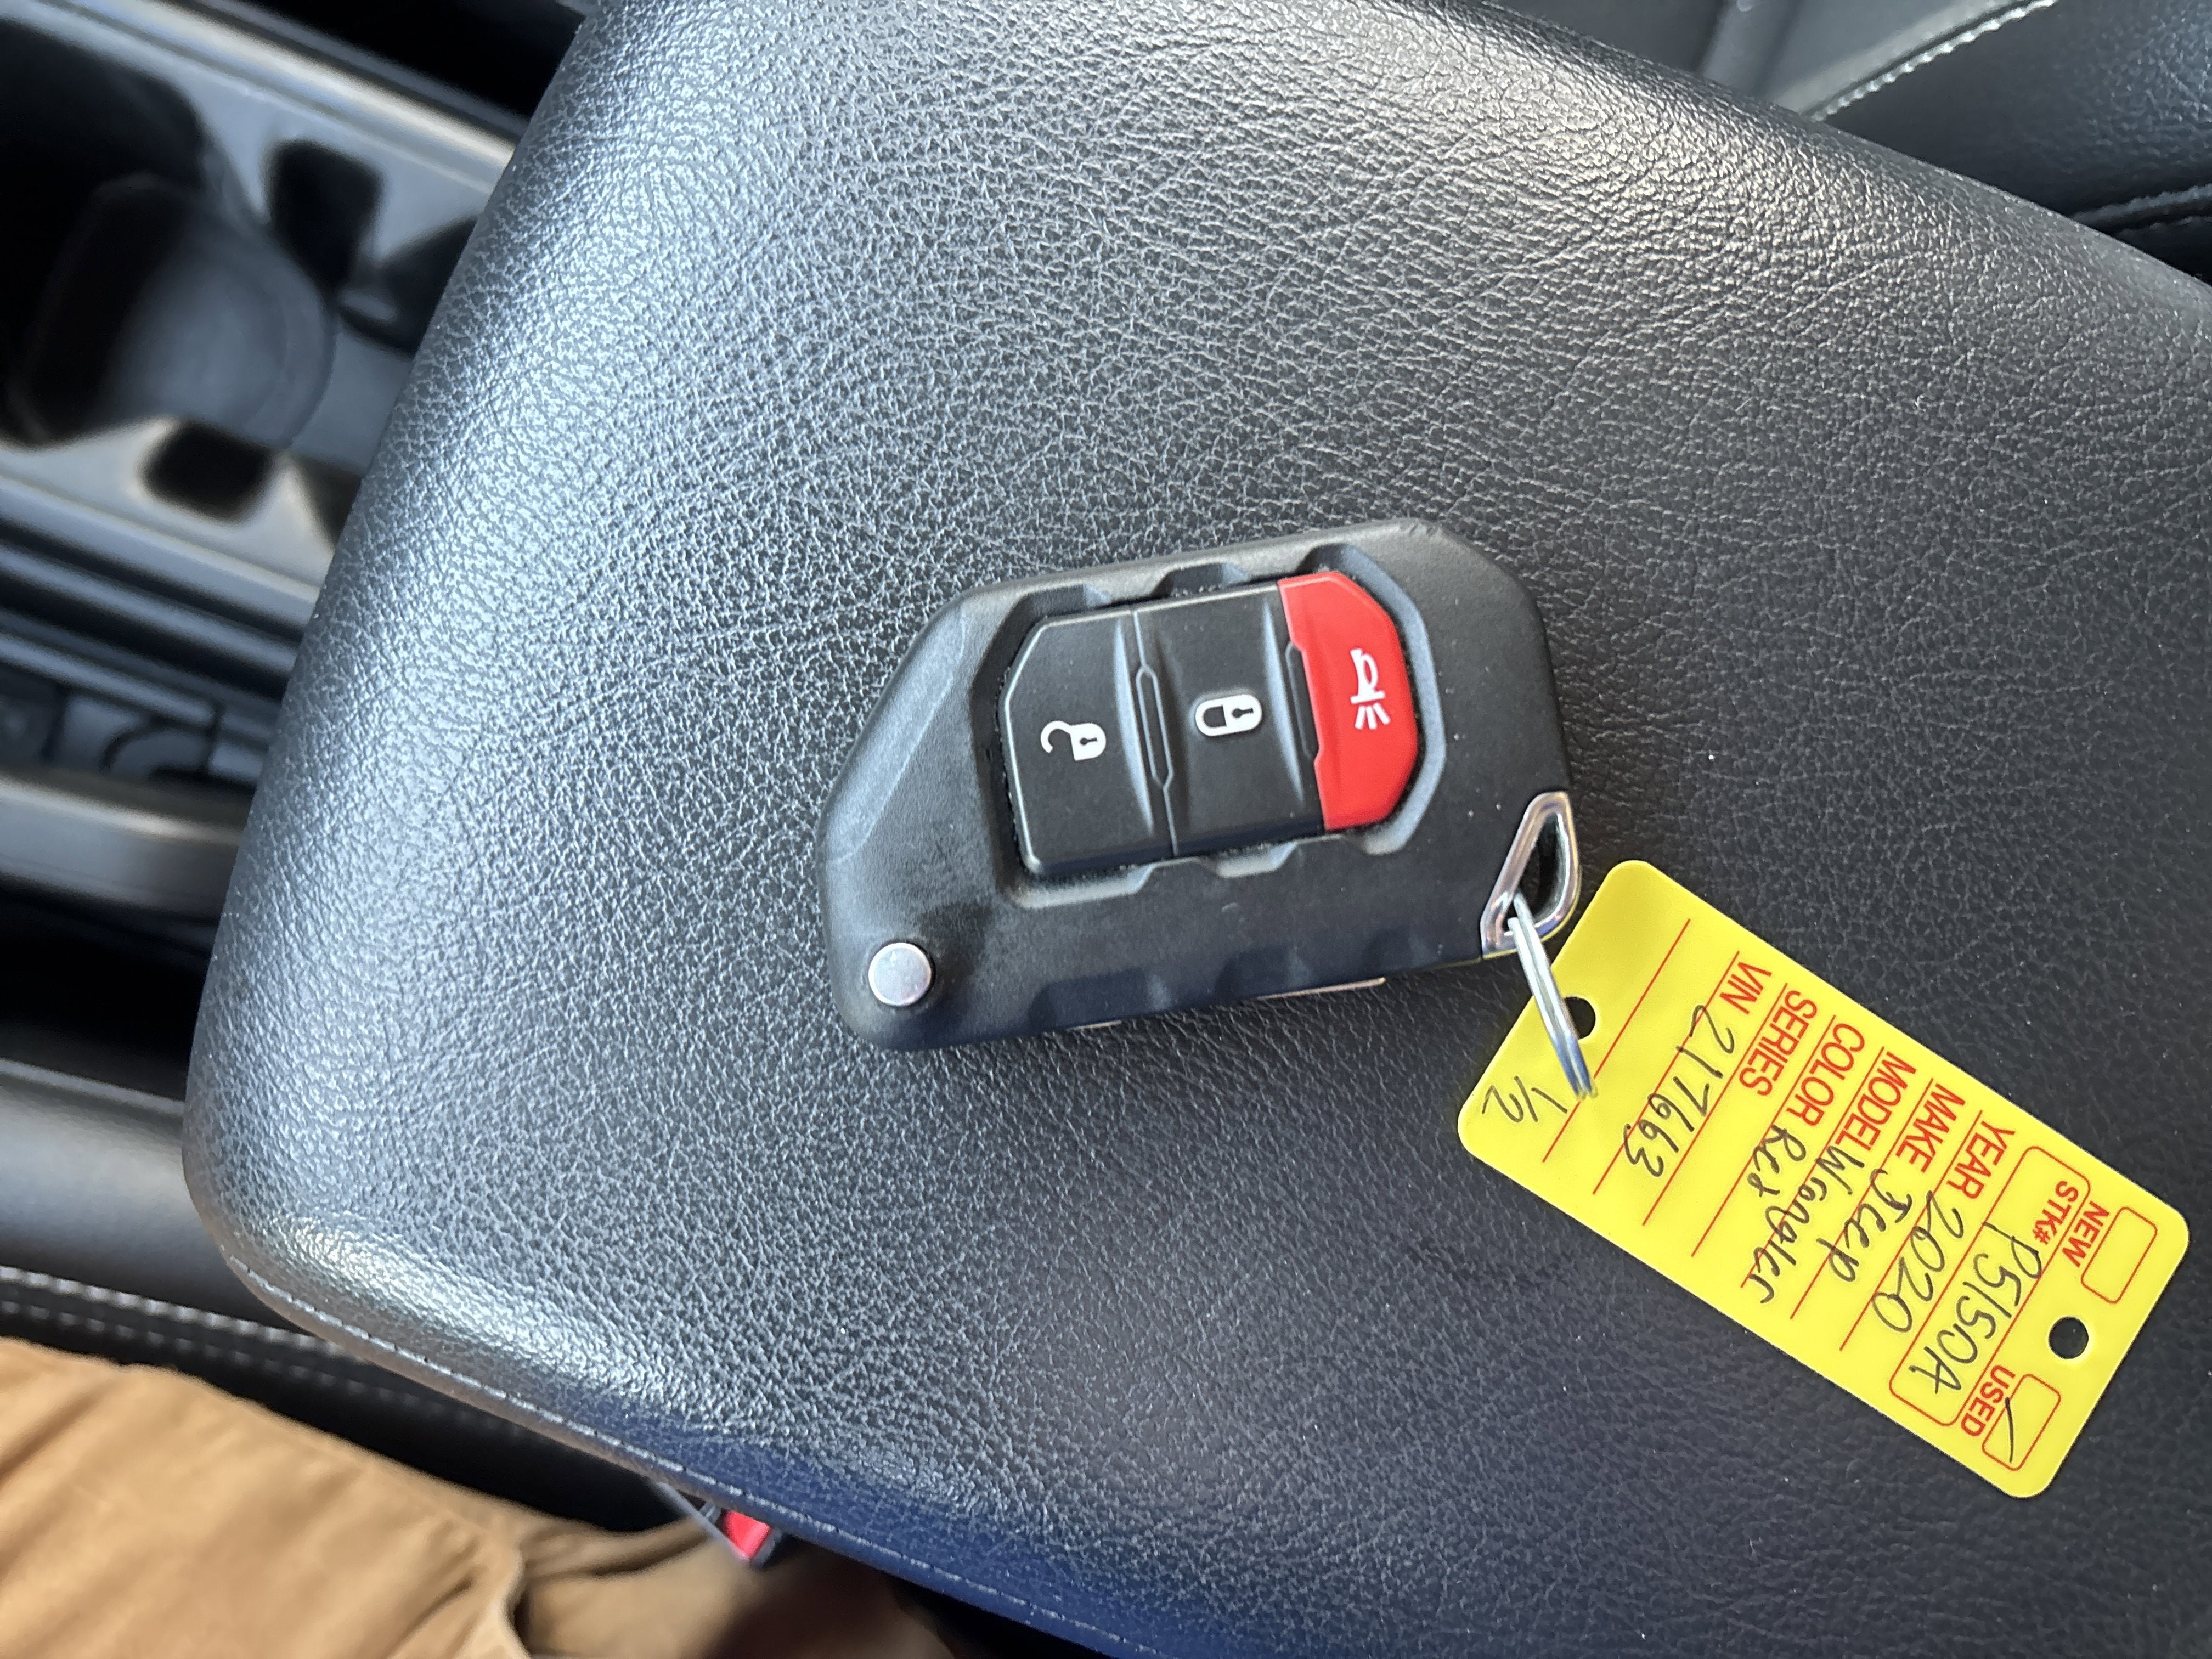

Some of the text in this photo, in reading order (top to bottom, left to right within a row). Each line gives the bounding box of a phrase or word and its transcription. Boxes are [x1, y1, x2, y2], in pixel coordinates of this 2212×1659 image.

[1623, 961, 1771, 1177] VIN 217663
[1739, 990, 1818, 1096] SERIES
[1747, 1023, 1865, 1211] COLOR Red
[1748, 1051, 1916, 1304] MODEL Wrangler
[1816, 1083, 1966, 1282] MAKE Jeep
[1870, 1120, 2015, 1333] YEAR 2020
[2032, 1180, 2079, 1245] STK#
[2062, 1200, 2110, 1267] NEW
[1960, 1364, 2016, 1436] USED
